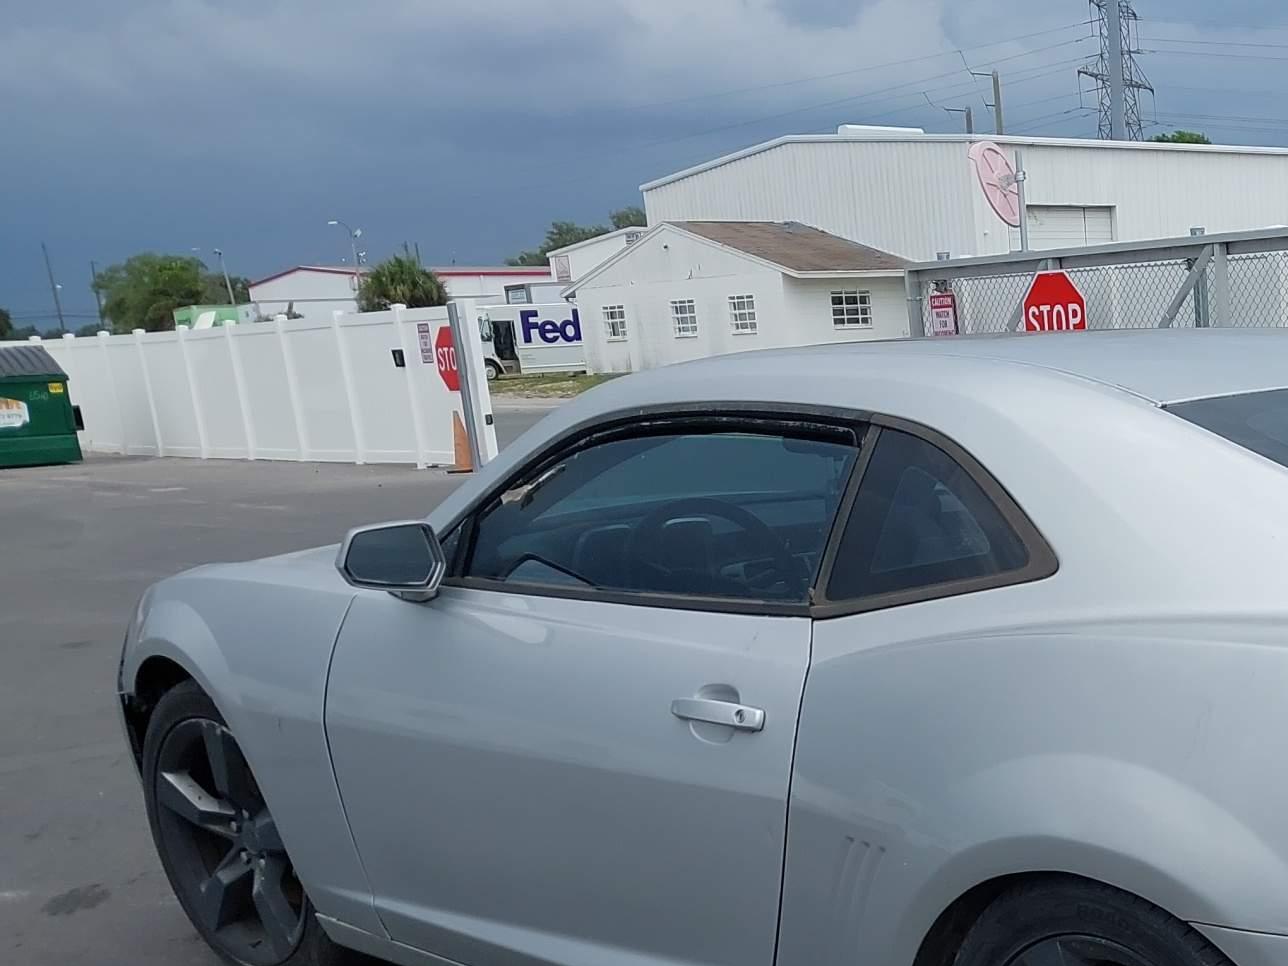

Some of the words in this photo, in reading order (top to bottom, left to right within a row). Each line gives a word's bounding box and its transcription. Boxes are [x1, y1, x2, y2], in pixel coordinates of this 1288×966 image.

[520, 308, 583, 344] Fed
[1028, 303, 1082, 331] STOP
[437, 346, 458, 371] STO
